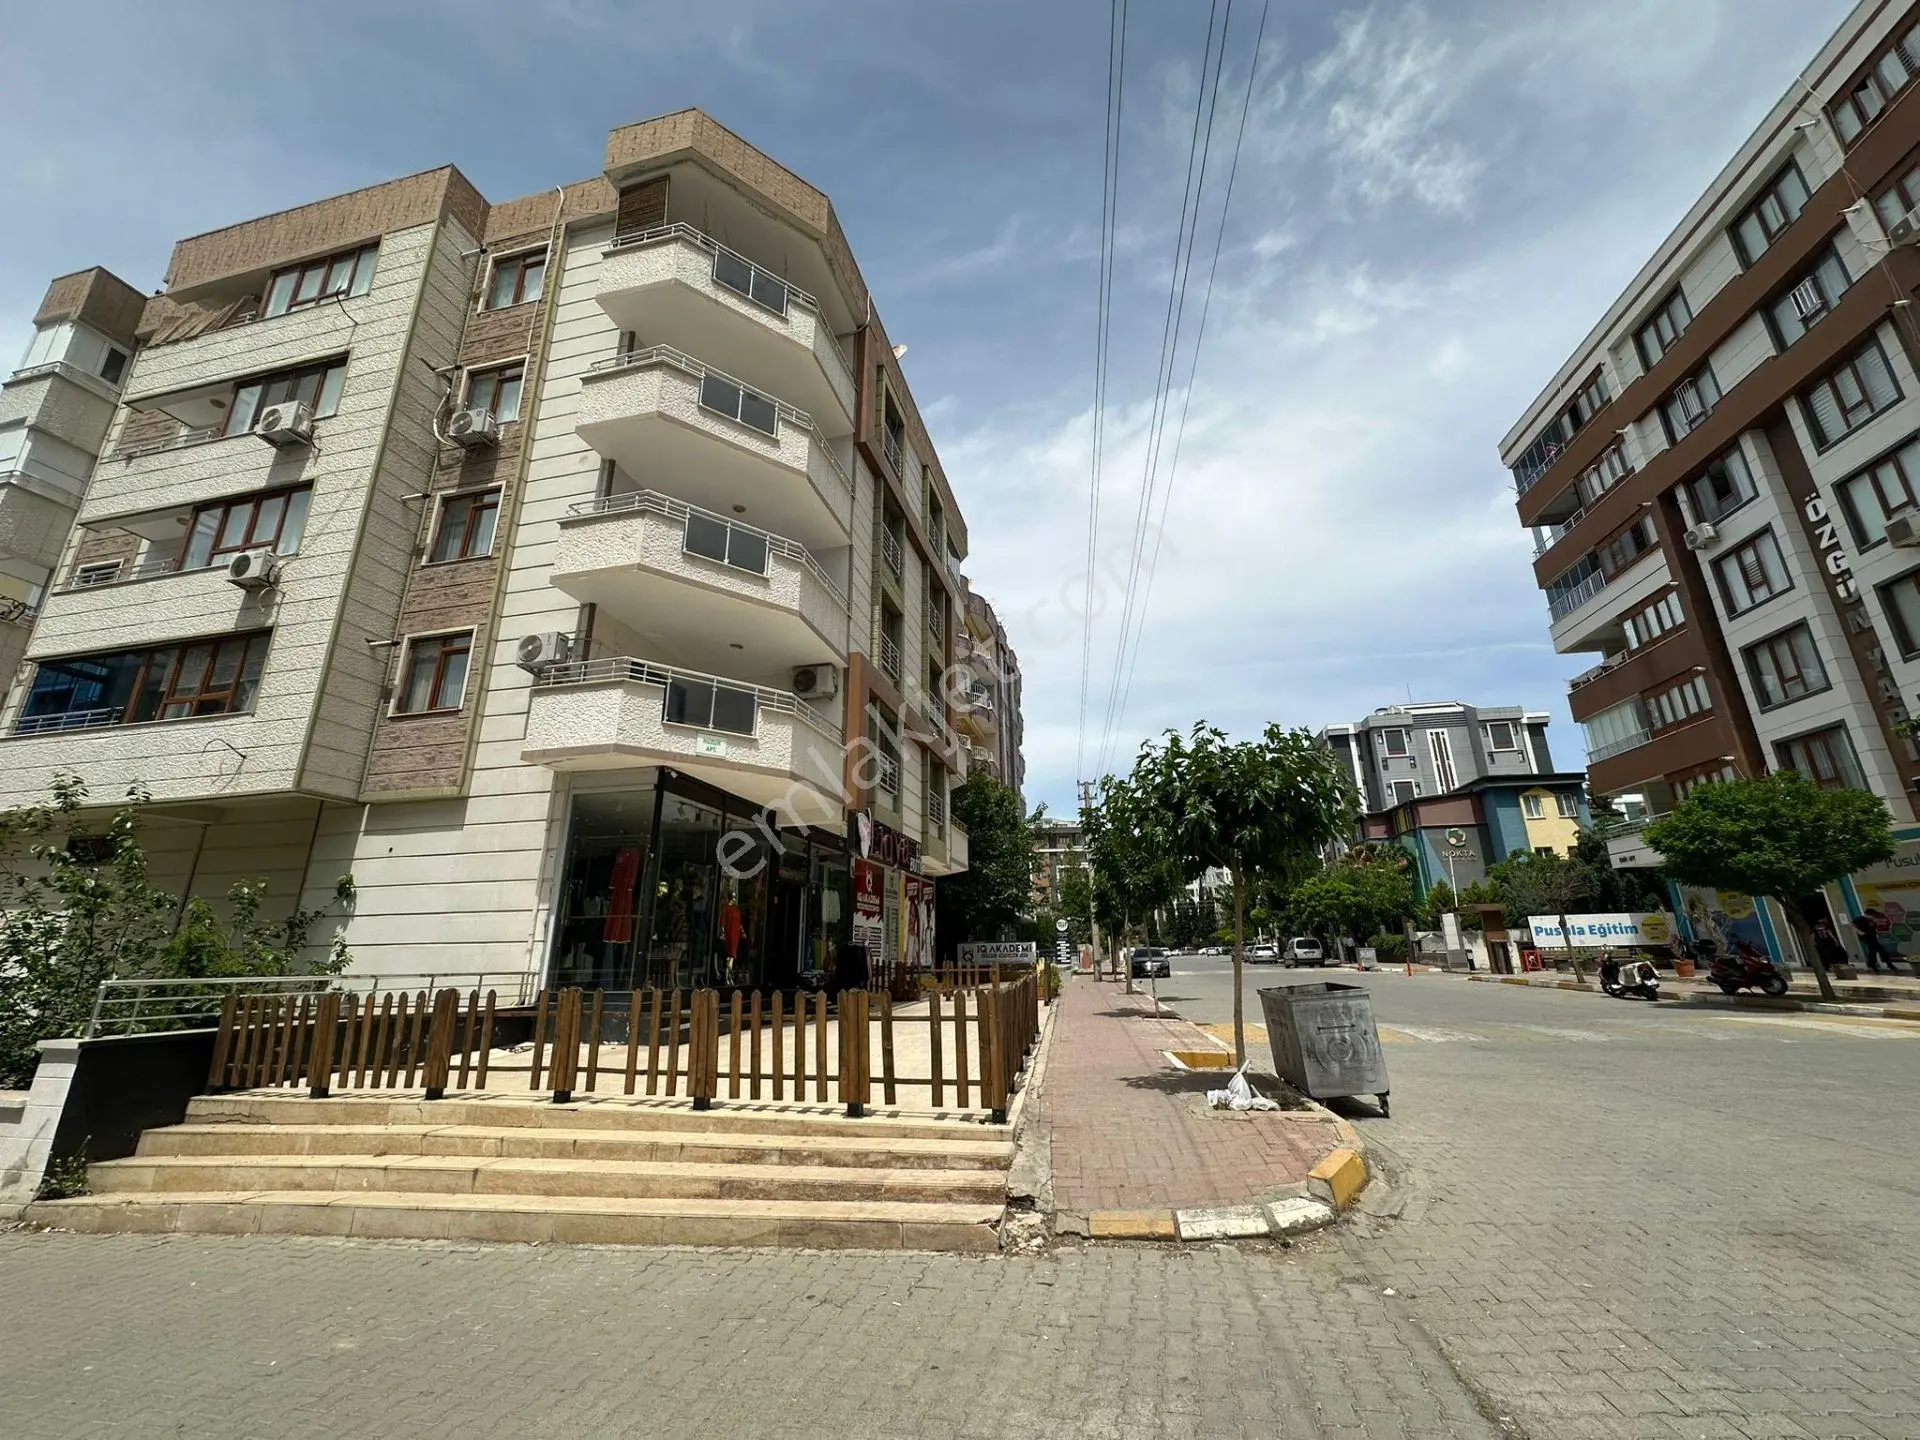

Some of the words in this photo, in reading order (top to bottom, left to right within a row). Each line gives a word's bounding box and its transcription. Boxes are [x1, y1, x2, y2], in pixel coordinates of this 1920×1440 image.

[1804, 491, 1873, 634] ÖZGÜN
[1441, 850, 1476, 858] NOKTA
[1588, 922, 1639, 938] Eğitim
[976, 944, 987, 953] IQ
